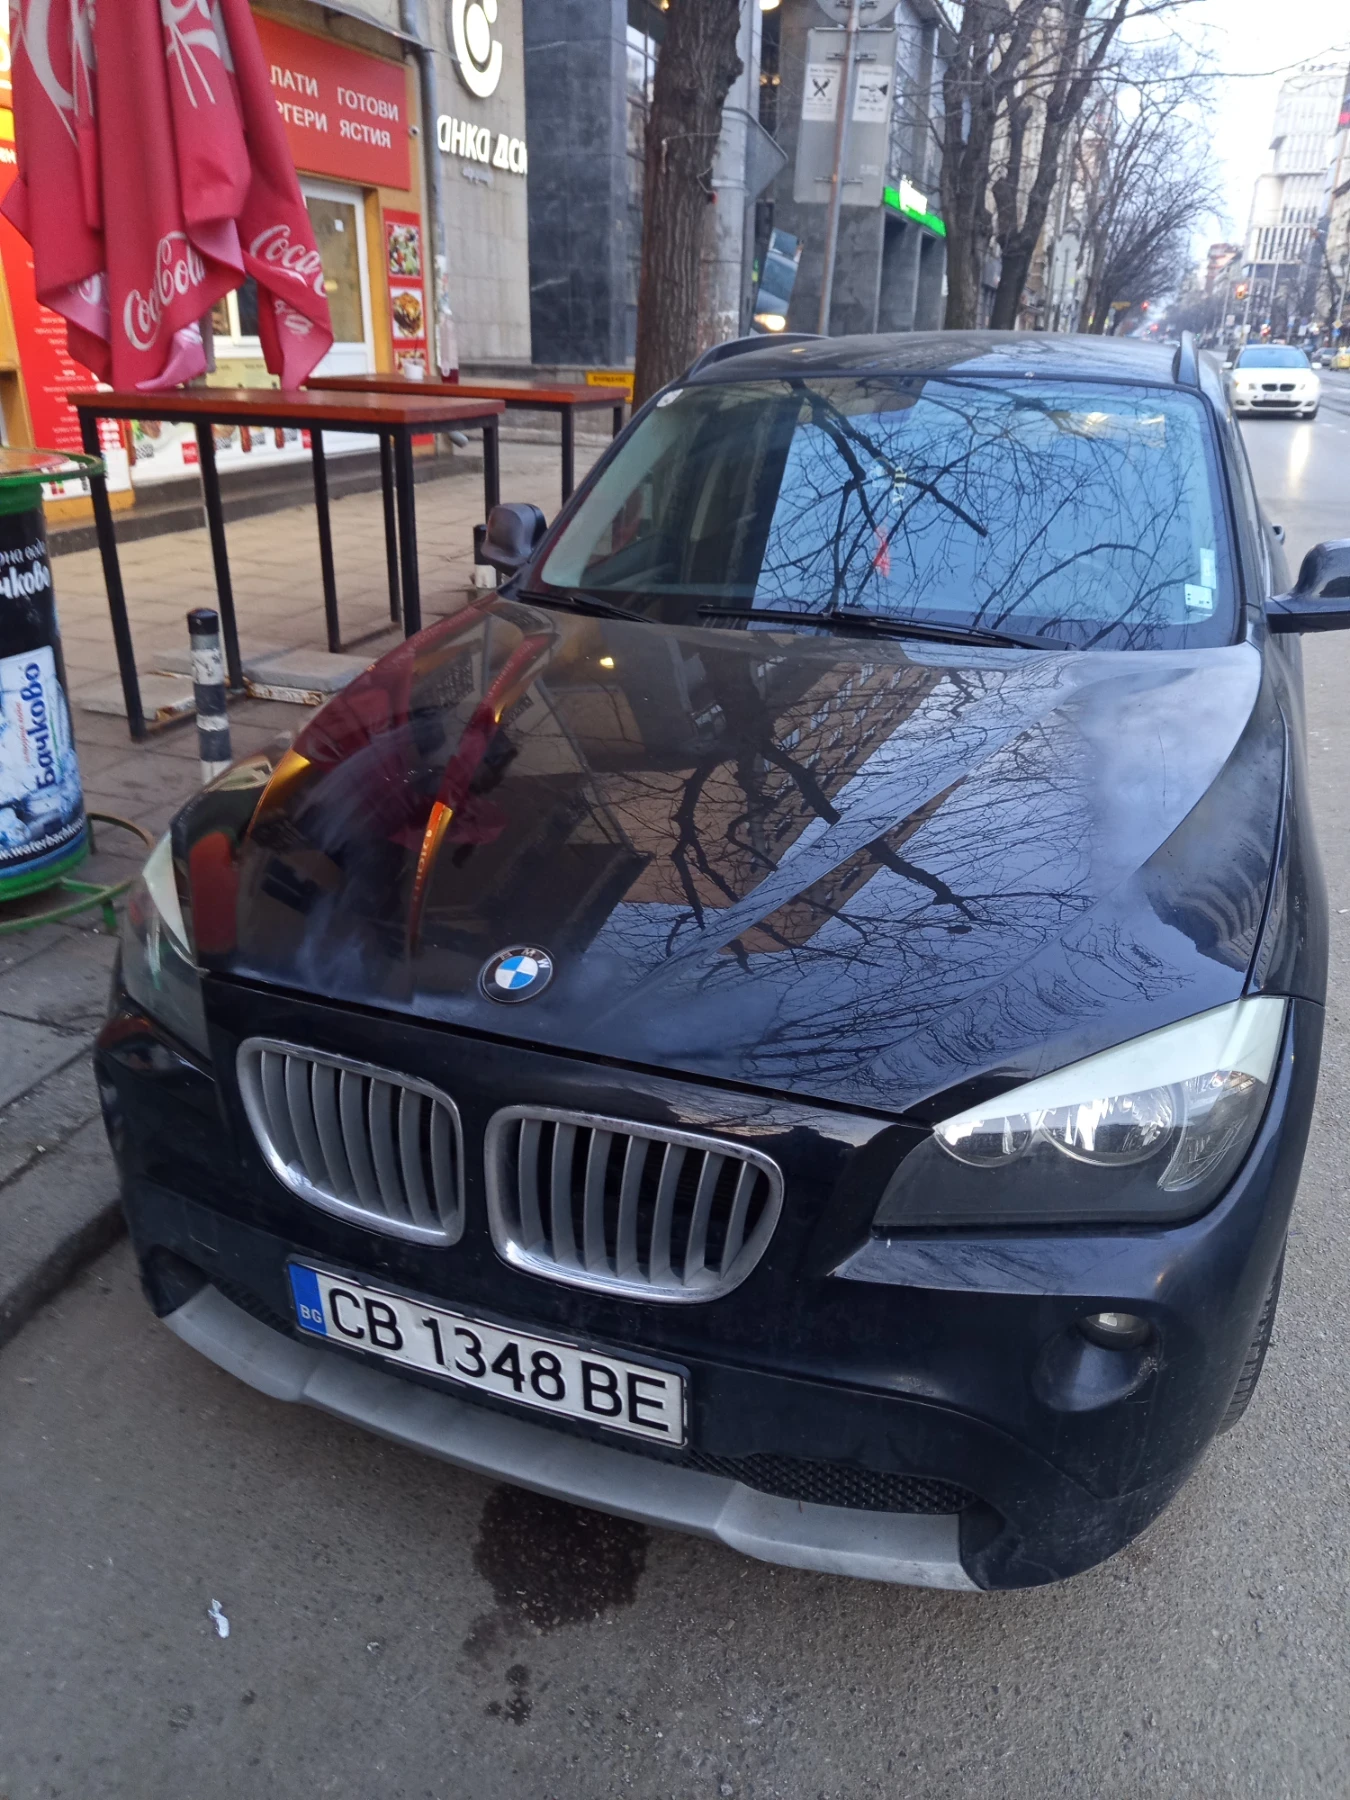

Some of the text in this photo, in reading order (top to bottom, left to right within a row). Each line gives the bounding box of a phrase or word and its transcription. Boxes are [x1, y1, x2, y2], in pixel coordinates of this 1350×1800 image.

[270, 64, 319, 98] ЛАТИ
[337, 86, 399, 122] ГОТОВИ
[339, 119, 392, 149] ЯСТИЯ
[21, 662, 56, 790] Бачково
[500, 948, 551, 969] BMW
[300, 1303, 323, 1325] BG
[328, 1287, 670, 1433] CB 1348 BE
